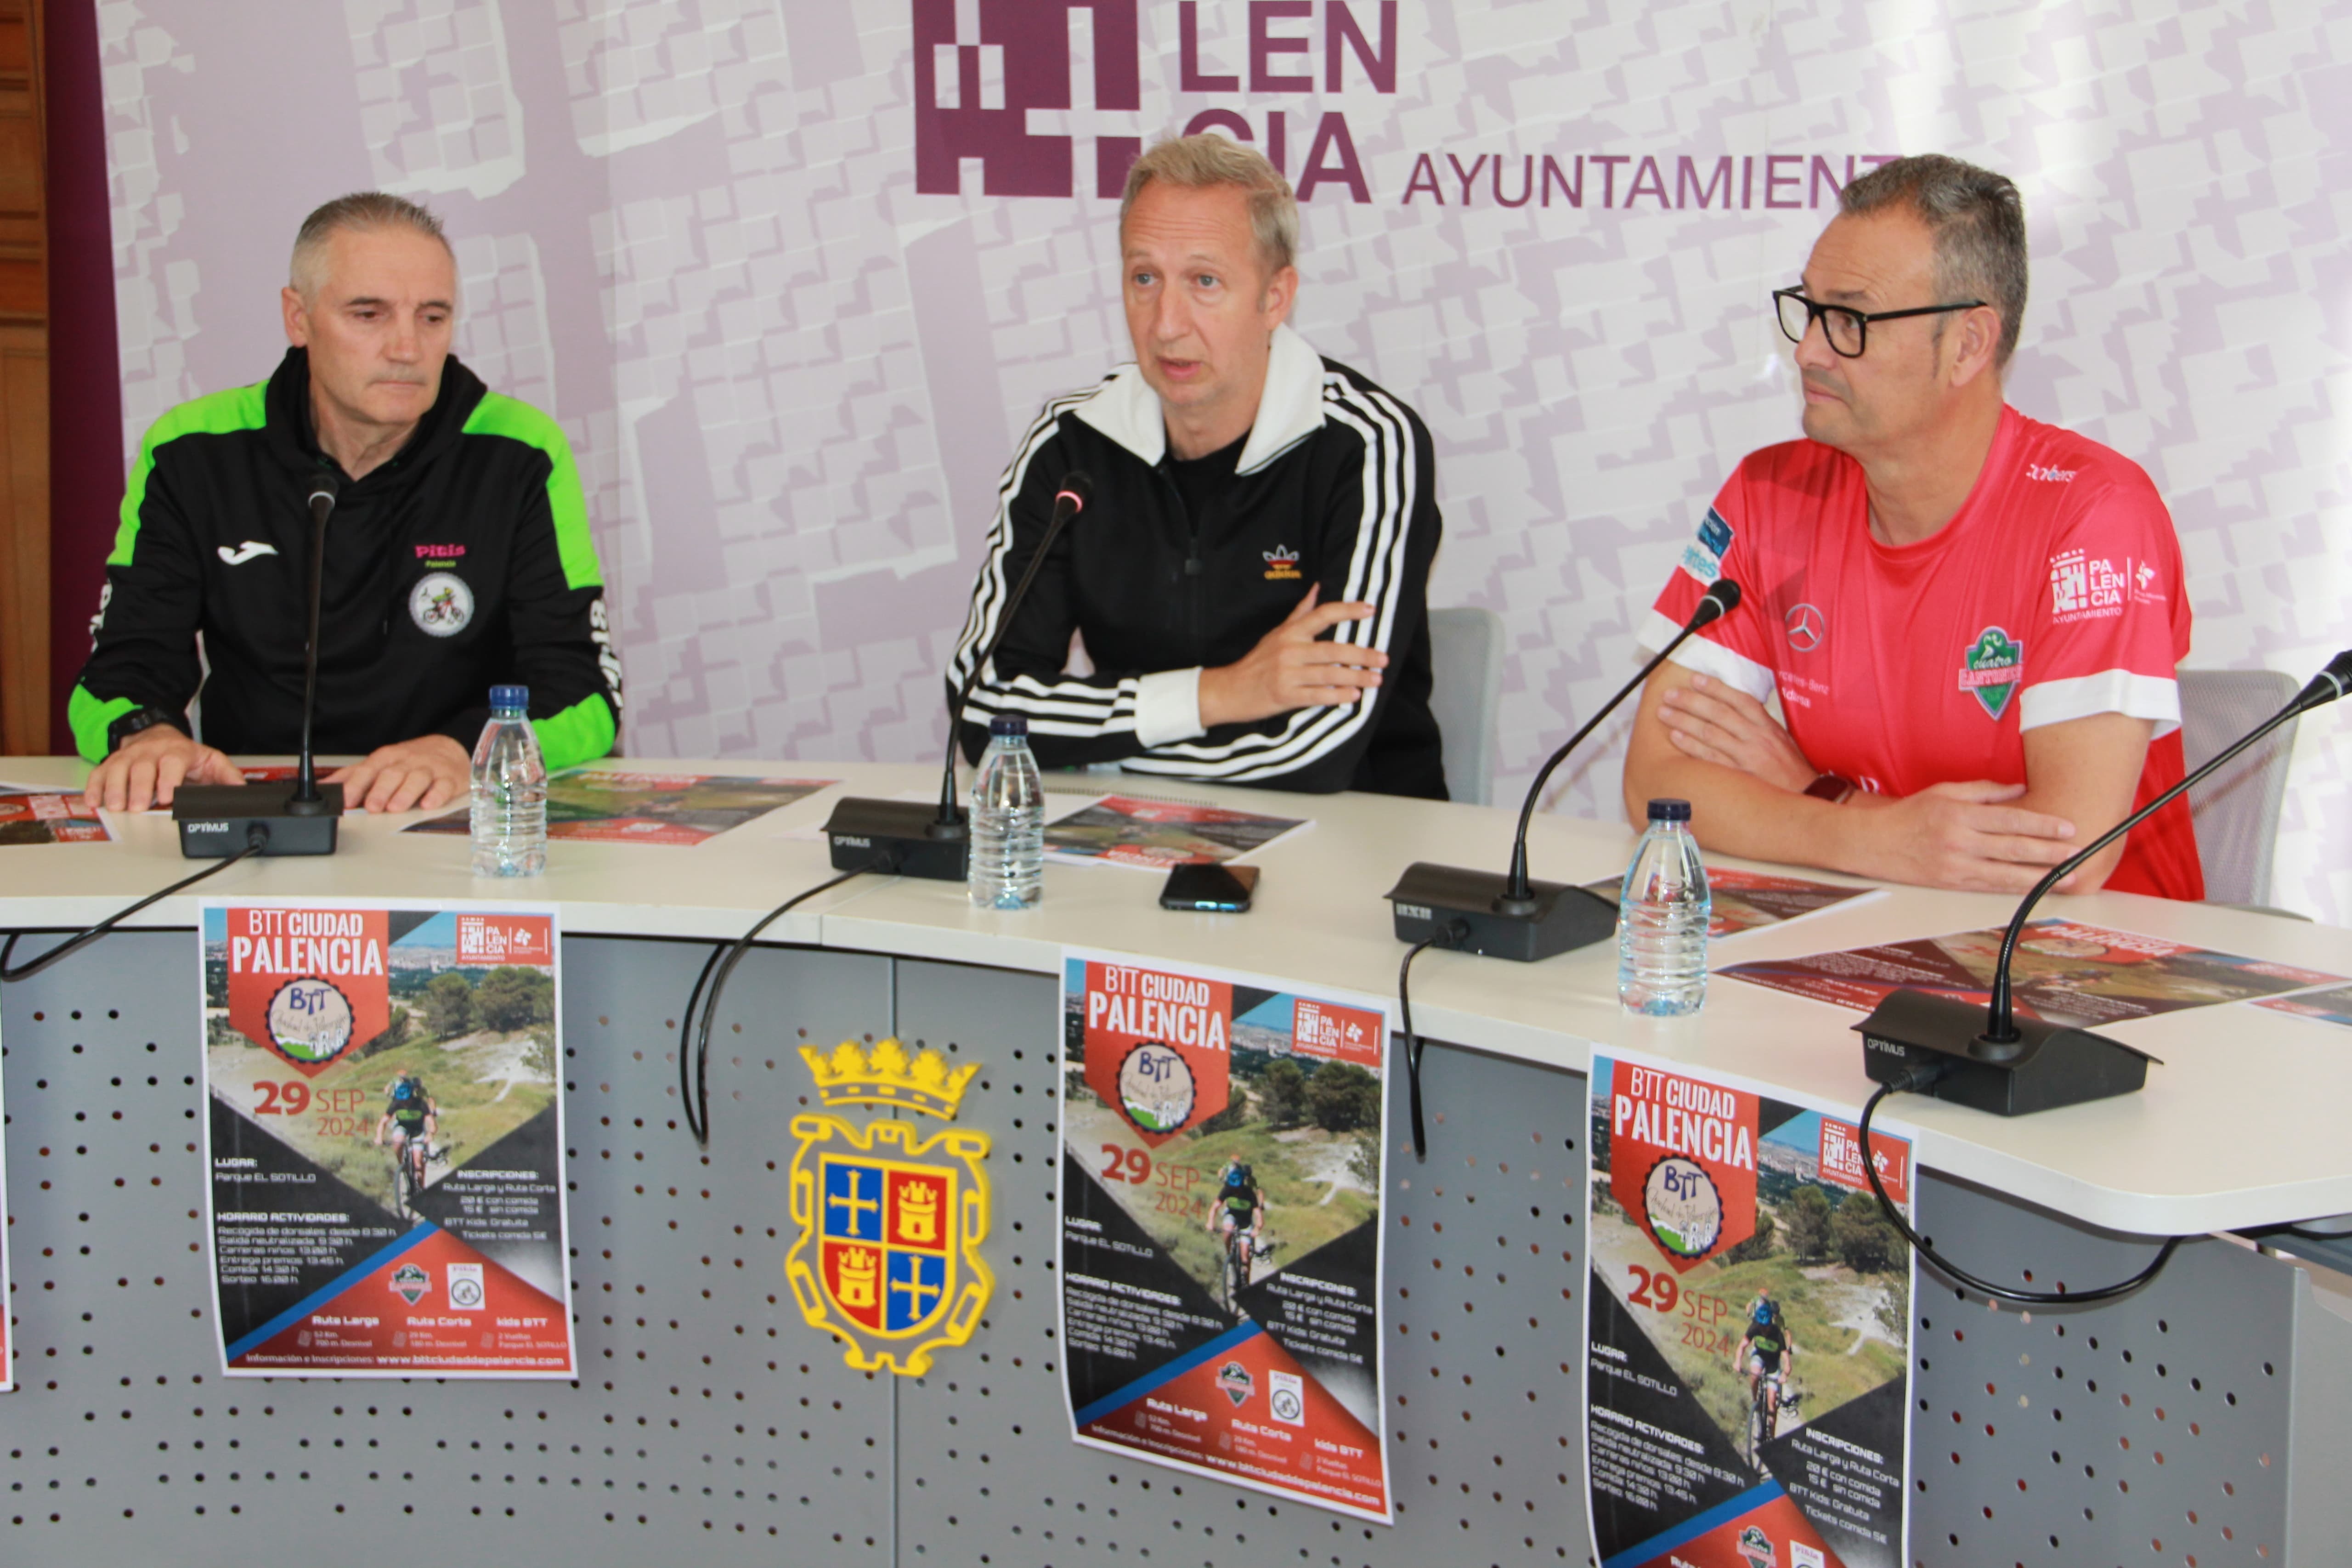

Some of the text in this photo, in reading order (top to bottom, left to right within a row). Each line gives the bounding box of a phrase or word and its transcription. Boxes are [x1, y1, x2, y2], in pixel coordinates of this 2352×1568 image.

[1179, 0, 1396, 93] LEN
[2089, 559, 2113, 574] PA
[2090, 573, 2125, 590] LEN
[2091, 589, 2121, 606] CIA
[2053, 607, 2122, 624] AYUNTAMIENTO
[249, 910, 364, 937] BTT CIUDAD
[486, 926, 500, 935] PA
[486, 935, 507, 945] LEN
[486, 945, 505, 954] CIA
[233, 936, 384, 975] PALENCIA
[1105, 966, 1210, 1007] BTT CIUDAD
[290, 988, 332, 1016] BTT
[1089, 991, 1226, 1051] PALENCIA
[1320, 1015, 1334, 1026] PA
[1320, 1025, 1340, 1038] LEN
[1319, 1036, 1337, 1047] CIA
[1139, 1051, 1178, 1082] BTT
[253, 1081, 365, 1115] 29 SEP
[1631, 1067, 1735, 1120] BTT CIUDAD
[317, 1117, 369, 1136] 2024
[1614, 1094, 1753, 1171] PALENCIA
[1846, 1139, 1859, 1152] PA
[215, 1158, 257, 1168] LUGAR:
[1102, 1143, 1200, 1191] 29 SEP
[1845, 1162, 1862, 1177] CIA
[215, 1172, 316, 1183] Parque EL SOTILLO
[457, 1170, 539, 1180] INSCRIPCIONES:
[1664, 1165, 1703, 1201] BTT
[443, 1183, 465, 1192] Ruta
[467, 1183, 496, 1193] Larga
[505, 1183, 527, 1192] Ruta
[529, 1184, 556, 1192] Corta
[1155, 1193, 1202, 1218] 2024
[216, 1212, 350, 1223] HORARIO ACTIVIDADES:
[444, 1217, 464, 1227] BTT
[490, 1218, 529, 1228] Gratuita
[462, 1230, 497, 1240] Tickets
[498, 1231, 531, 1240] comida
[1628, 1264, 1728, 1326] 29 SEP
[312, 1315, 379, 1328] Ruta Larga
[407, 1316, 472, 1327] Ruta Corta
[496, 1317, 548, 1328] kids BTT
[1681, 1323, 1730, 1357] 2024
[246, 1353, 302, 1363] Información
[1591, 1341, 1628, 1363] LUGAR:
[1590, 1358, 1678, 1397] Parque EL SOTILLO
[1147, 1397, 1208, 1421] Ruta Larga
[1231, 1419, 1292, 1442] Ruta Corta
[1590, 1420, 1630, 1443] Recogida
[1590, 1432, 1618, 1449] Salida
[1591, 1404, 1705, 1455] HORARIO ACTIVIDADES:
[1339, 1445, 1363, 1459] BTT
[1591, 1443, 1630, 1466] Carreras
[1806, 1427, 1884, 1465] INSCRIPCIONES:
[1592, 1455, 1626, 1477] Entrega
[1792, 1438, 1900, 1488] Ruta Larga y Ruta Corta
[1806, 1460, 1882, 1498] 20 € con comida
[1790, 1482, 1809, 1497] BTT
[1832, 1499, 1871, 1522] Gratuita
[1809, 1473, 1881, 1510] 15 € sin comida
[1805, 1505, 1888, 1545] Tickets comida 5€
